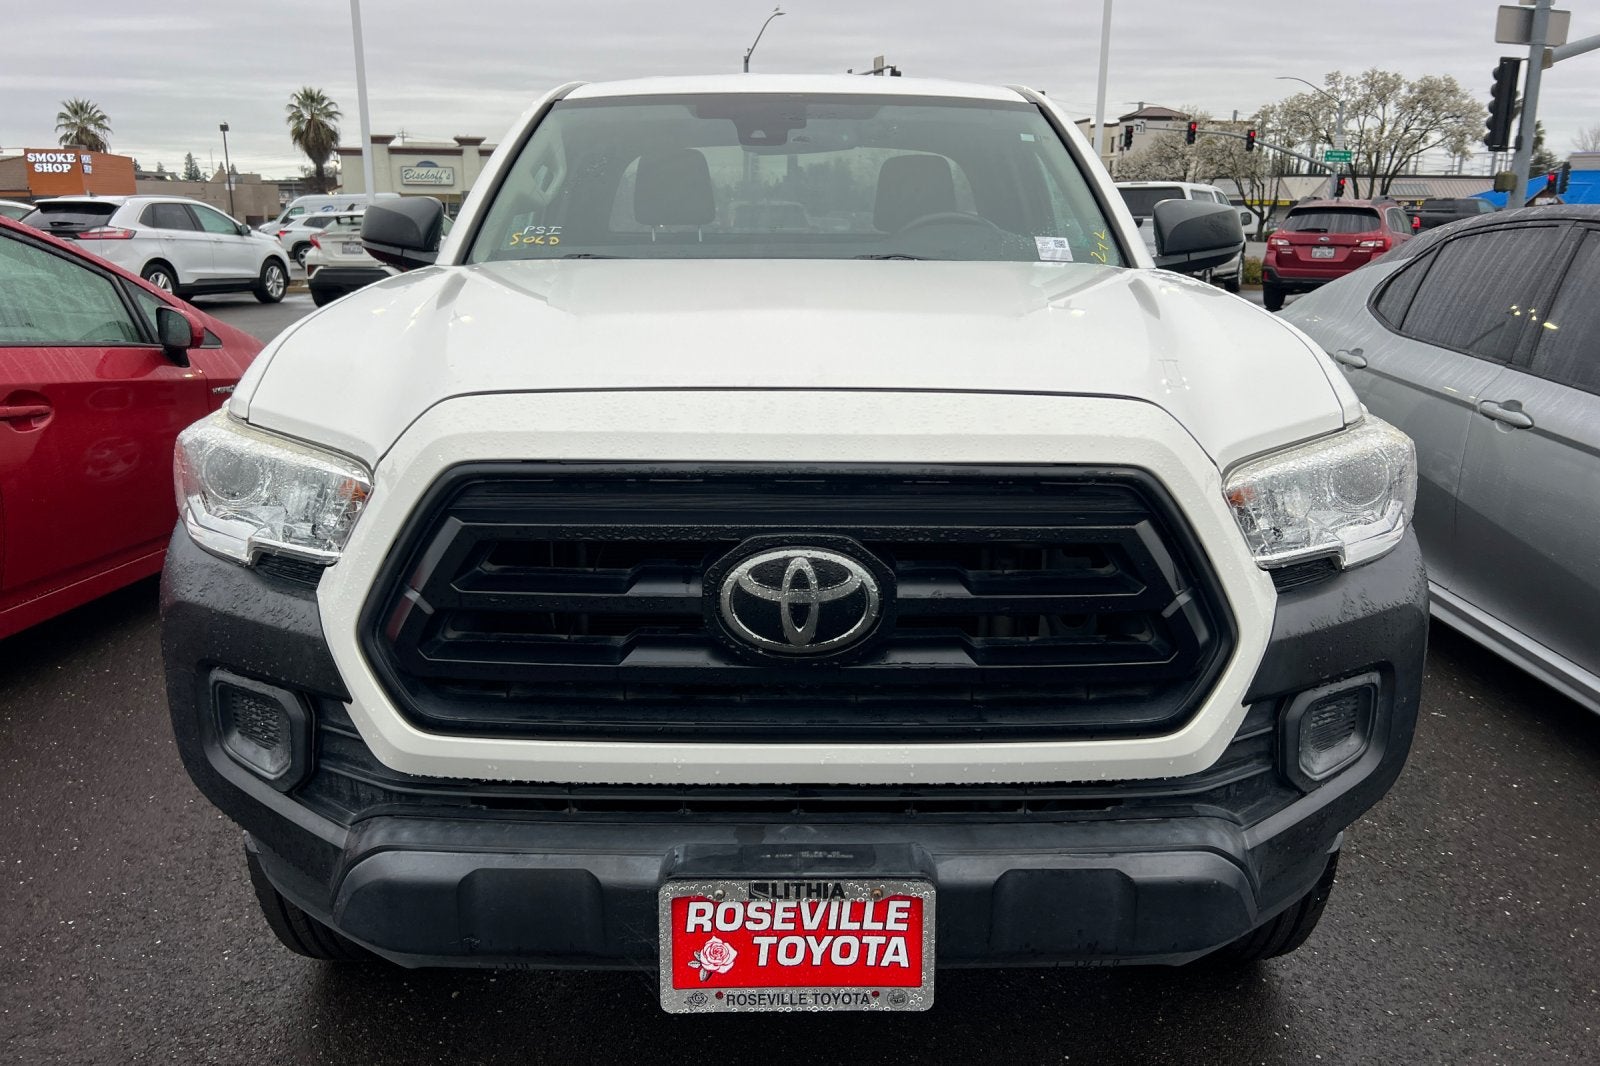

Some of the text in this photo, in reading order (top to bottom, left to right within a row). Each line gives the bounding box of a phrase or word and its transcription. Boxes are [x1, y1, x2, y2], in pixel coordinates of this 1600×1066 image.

[27, 153, 76, 163] SMOKE
[34, 163, 72, 173] SHOP
[403, 169, 451, 183] Bischoff's
[523, 225, 562, 235] PSI
[510, 232, 560, 246] SOLD
[771, 882, 846, 900] LITHIA
[685, 900, 912, 933] ROSEVILLE
[752, 935, 911, 968] TOYOTA
[726, 991, 807, 1007] ROSEVILLE
[813, 991, 871, 1006] TOYOTA
